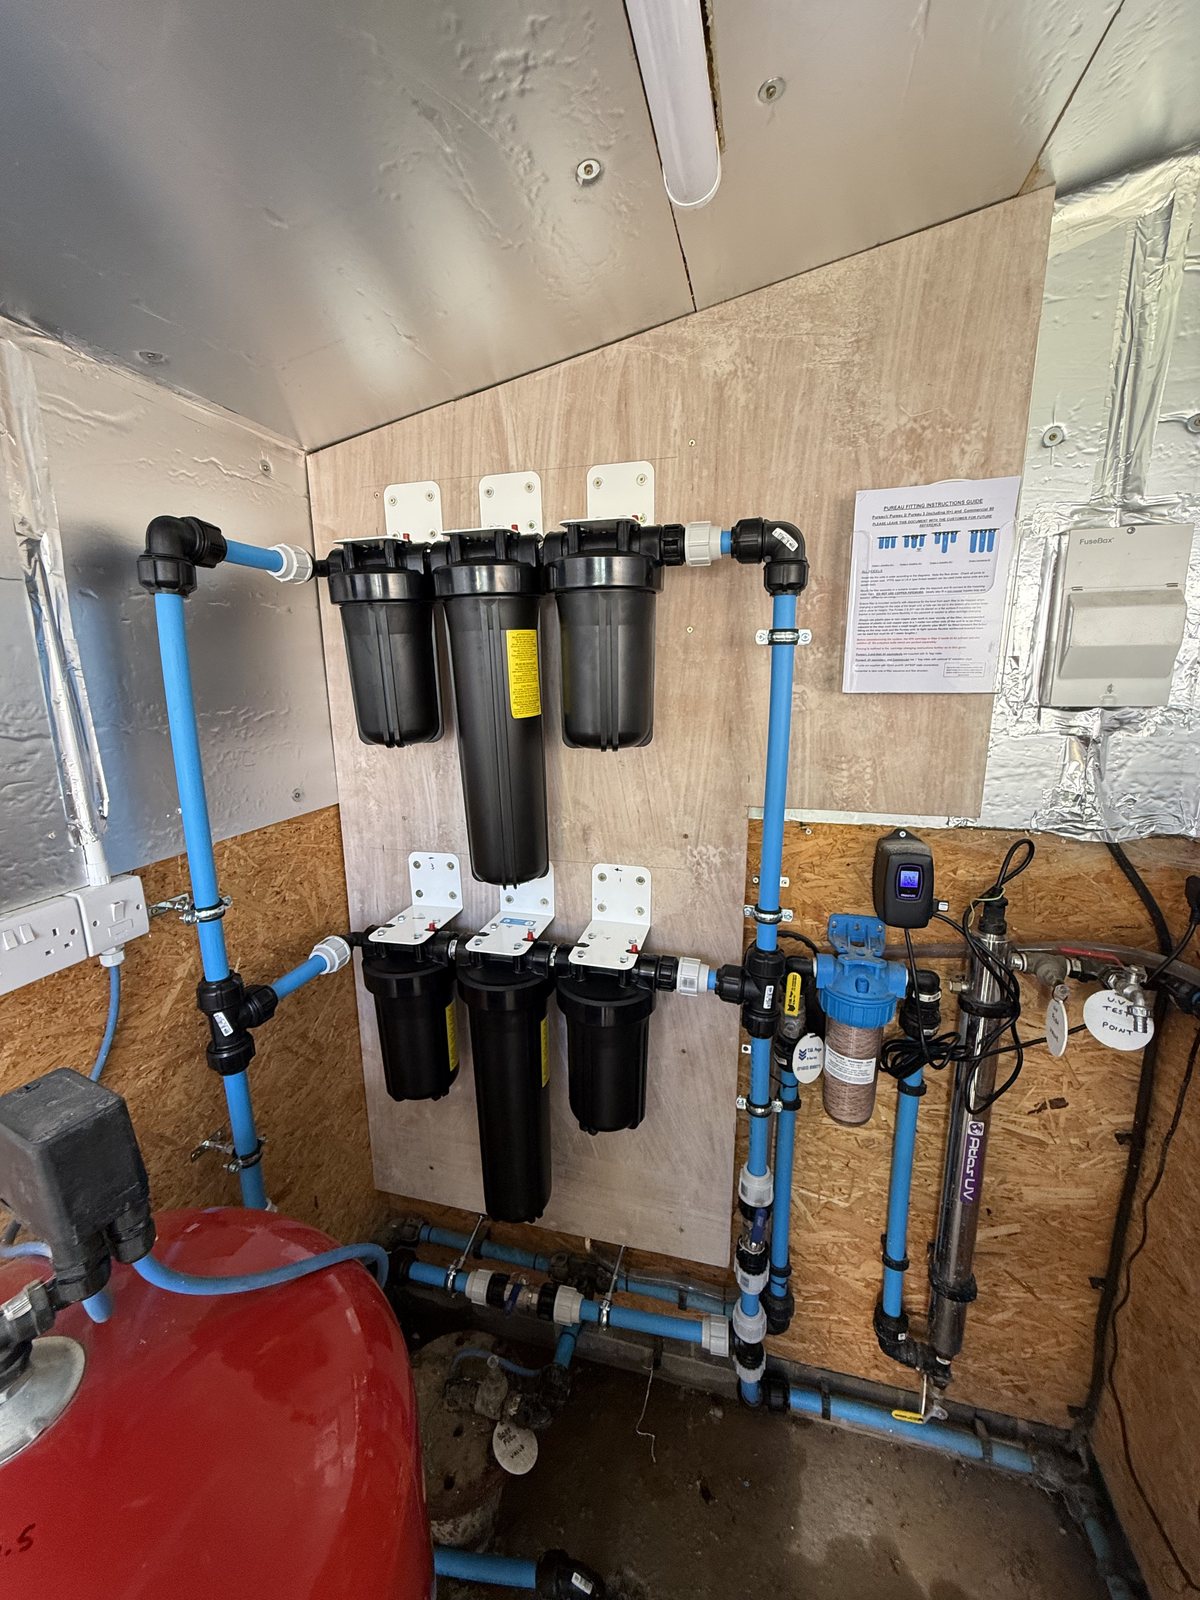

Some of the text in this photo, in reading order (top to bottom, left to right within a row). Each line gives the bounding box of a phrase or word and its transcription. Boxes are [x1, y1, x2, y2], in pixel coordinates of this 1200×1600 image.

[926, 500, 964, 508] INSTRUCTIONS
[966, 498, 983, 506] GUIDE
[1079, 537, 1112, 545] FuseBox
[1102, 1021, 1133, 1036] POINT
[963, 1137, 980, 1201] Atlas UV
